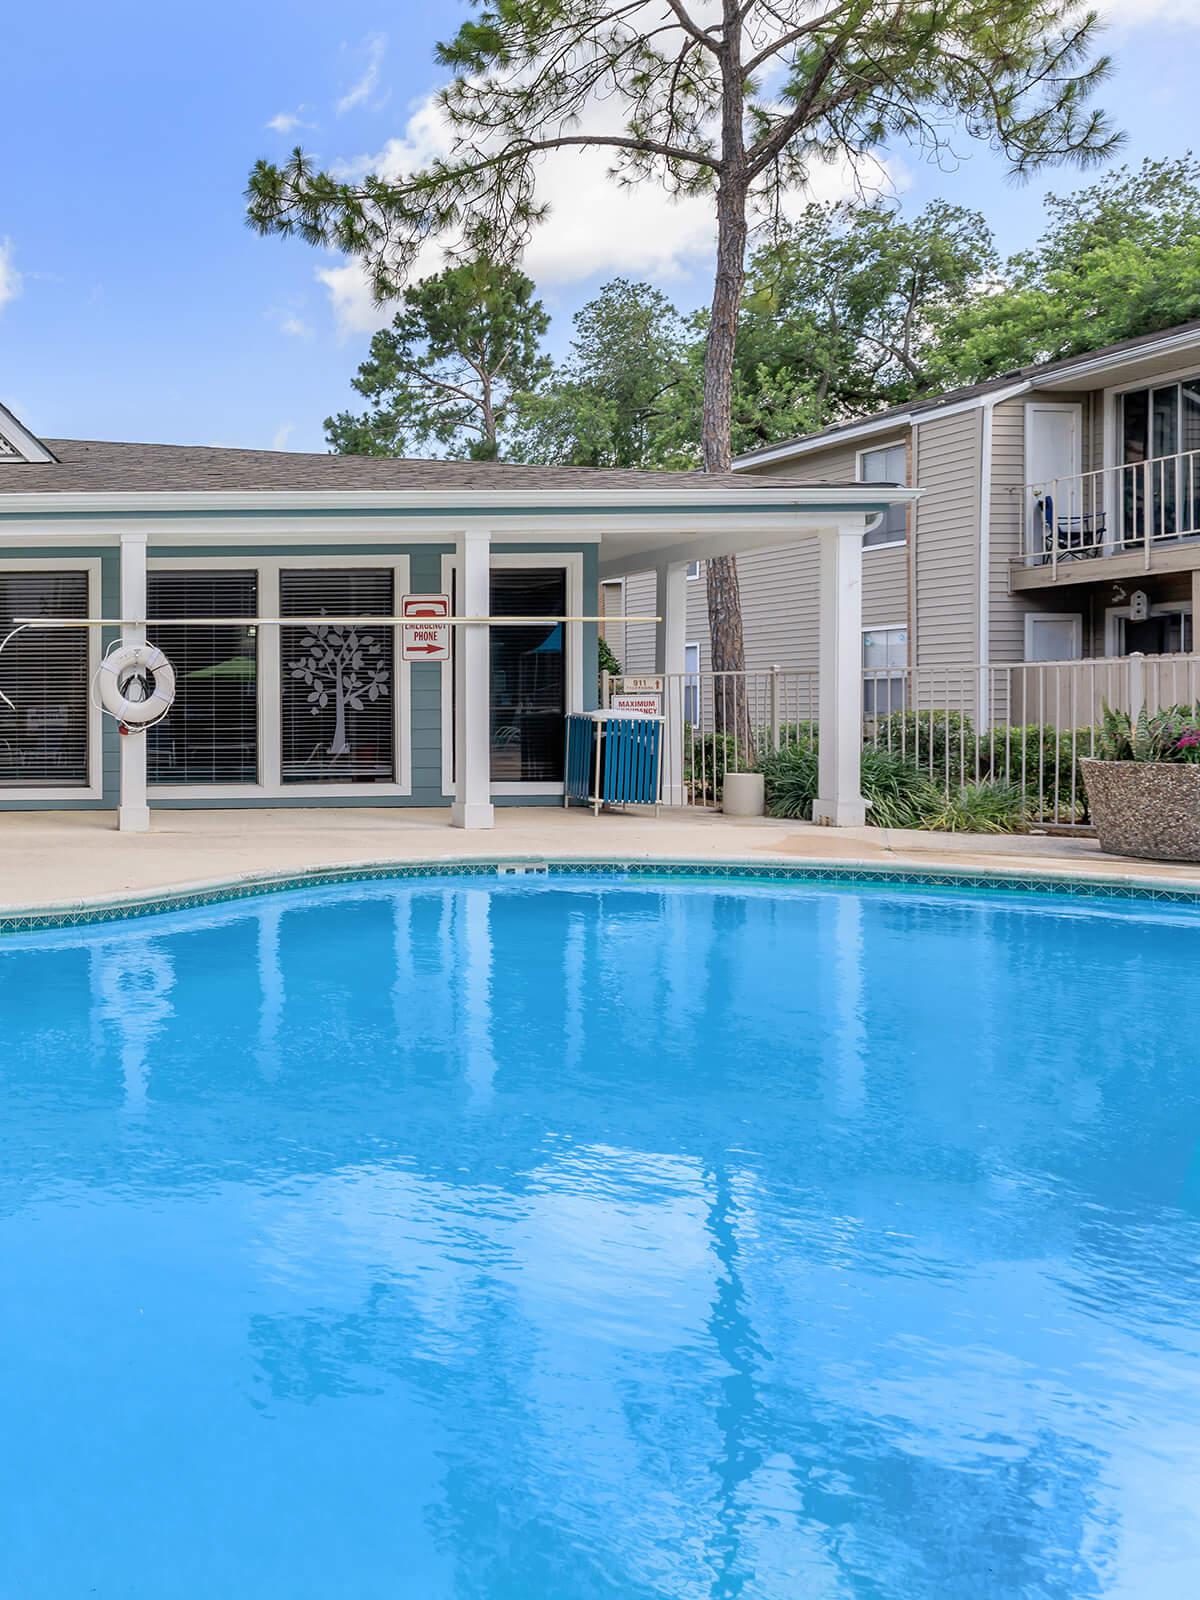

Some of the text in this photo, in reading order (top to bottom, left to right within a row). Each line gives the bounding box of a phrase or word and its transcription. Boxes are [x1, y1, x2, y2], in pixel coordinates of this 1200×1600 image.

[413, 631, 438, 641] PHONE
[633, 679, 647, 687] 911
[618, 700, 656, 708] MAXIMUM
